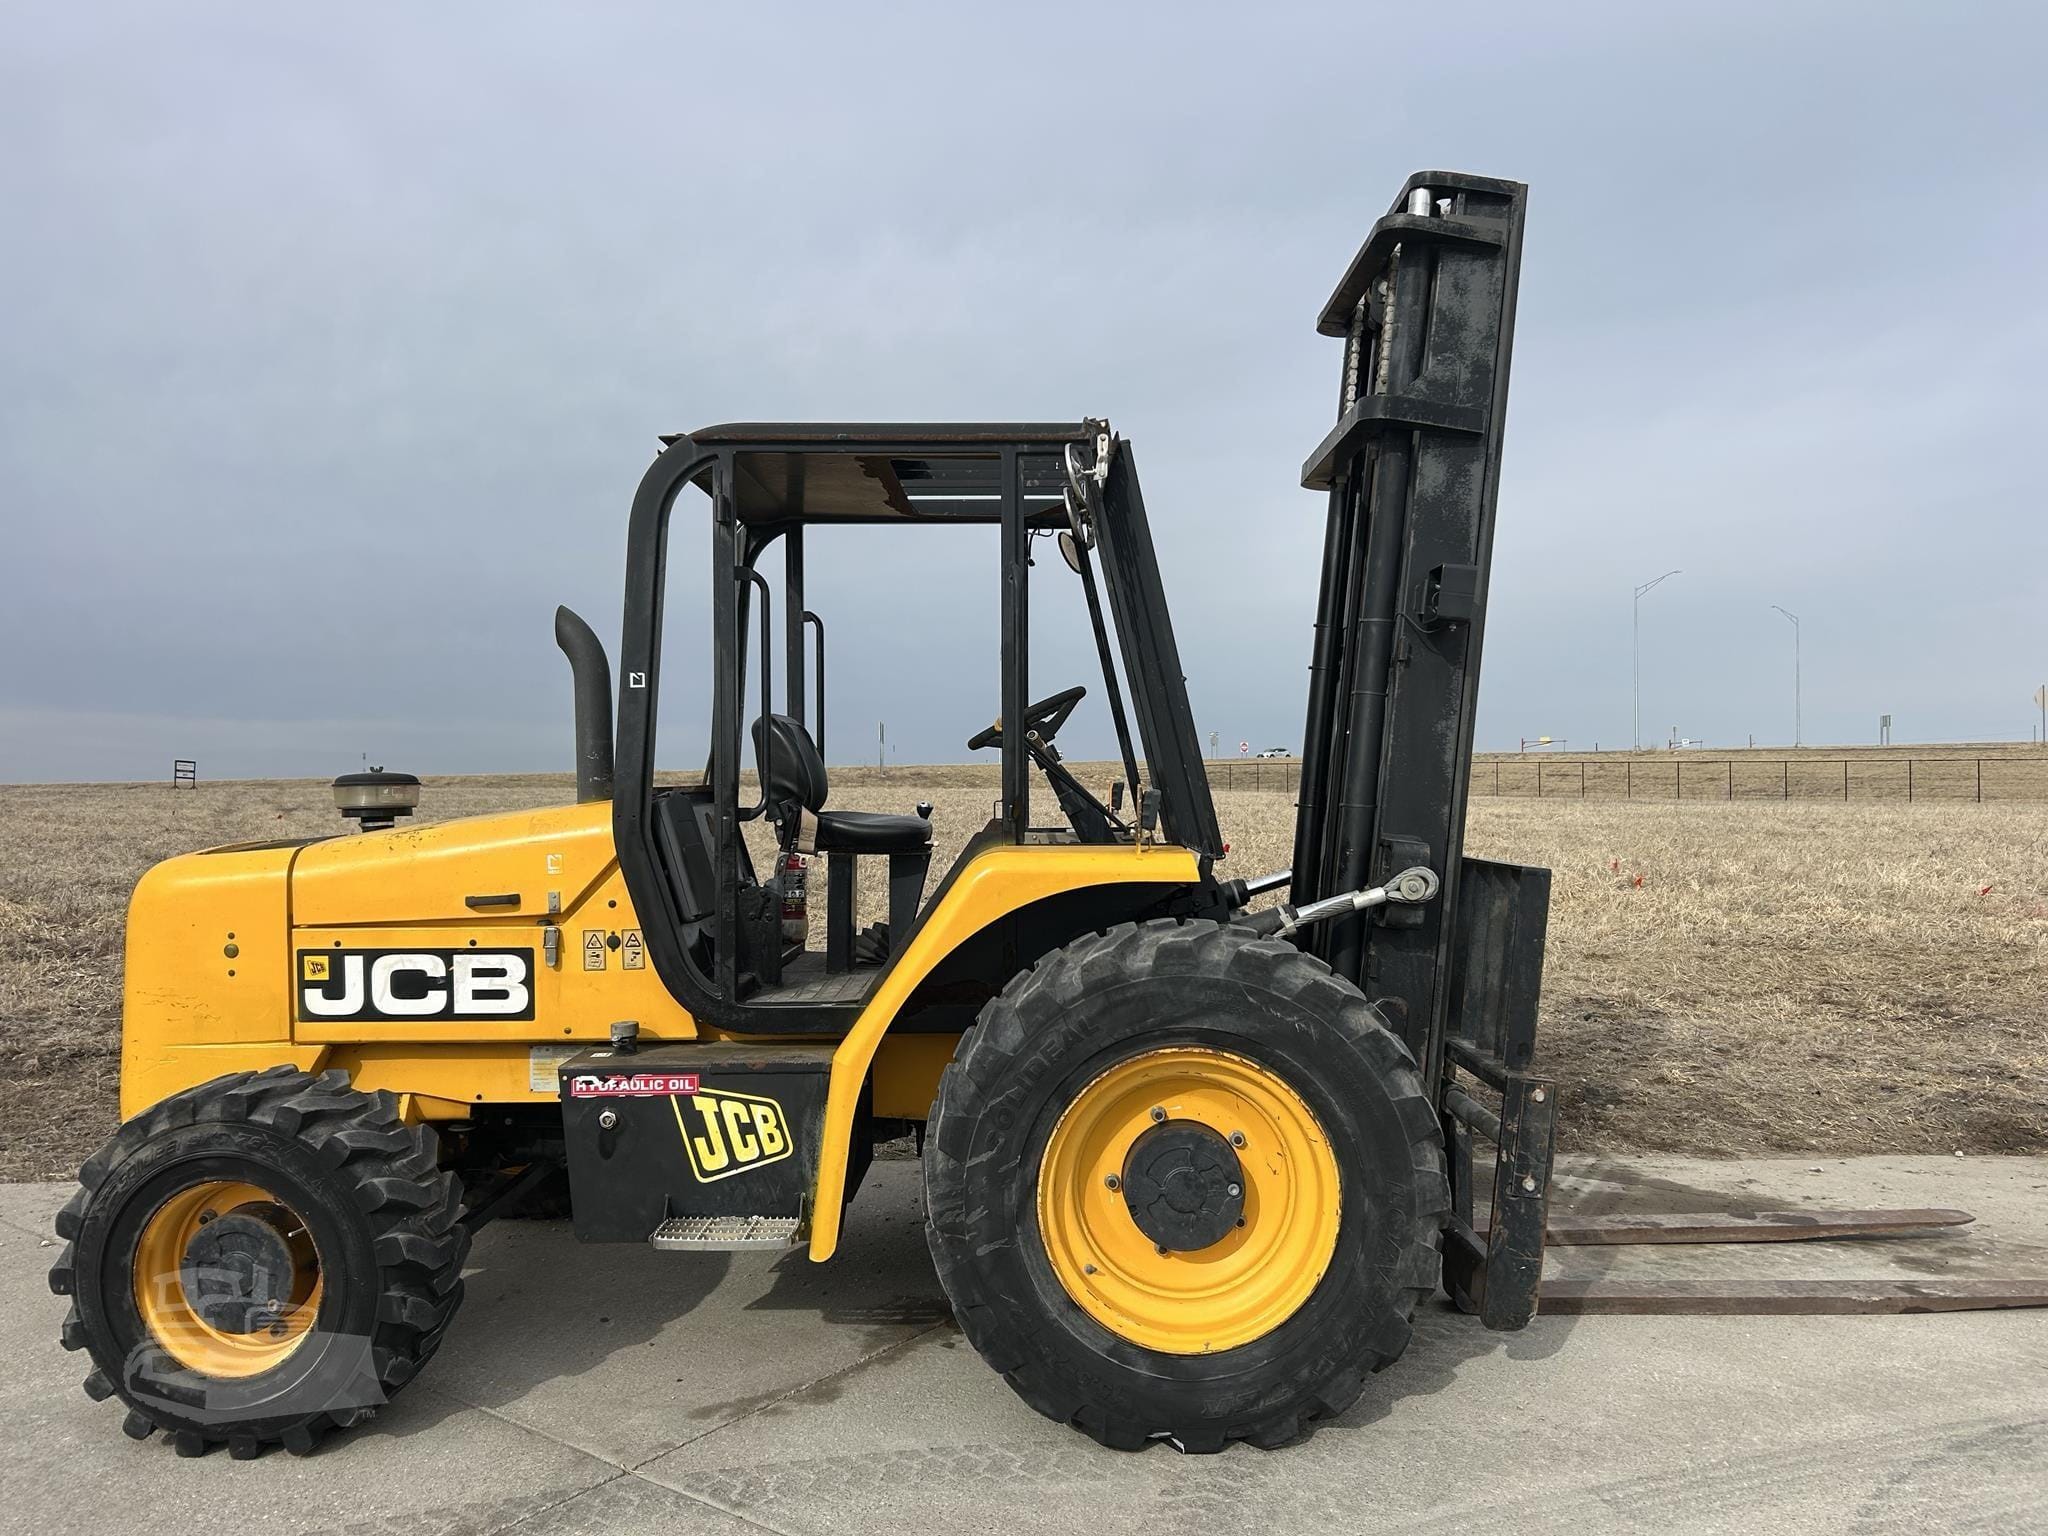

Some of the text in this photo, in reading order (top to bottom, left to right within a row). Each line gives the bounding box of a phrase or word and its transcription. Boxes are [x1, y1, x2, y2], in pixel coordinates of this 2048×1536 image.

[304, 954, 529, 1015] JCB
[668, 1079, 694, 1090] OIL
[692, 1095, 784, 1171] JCB
